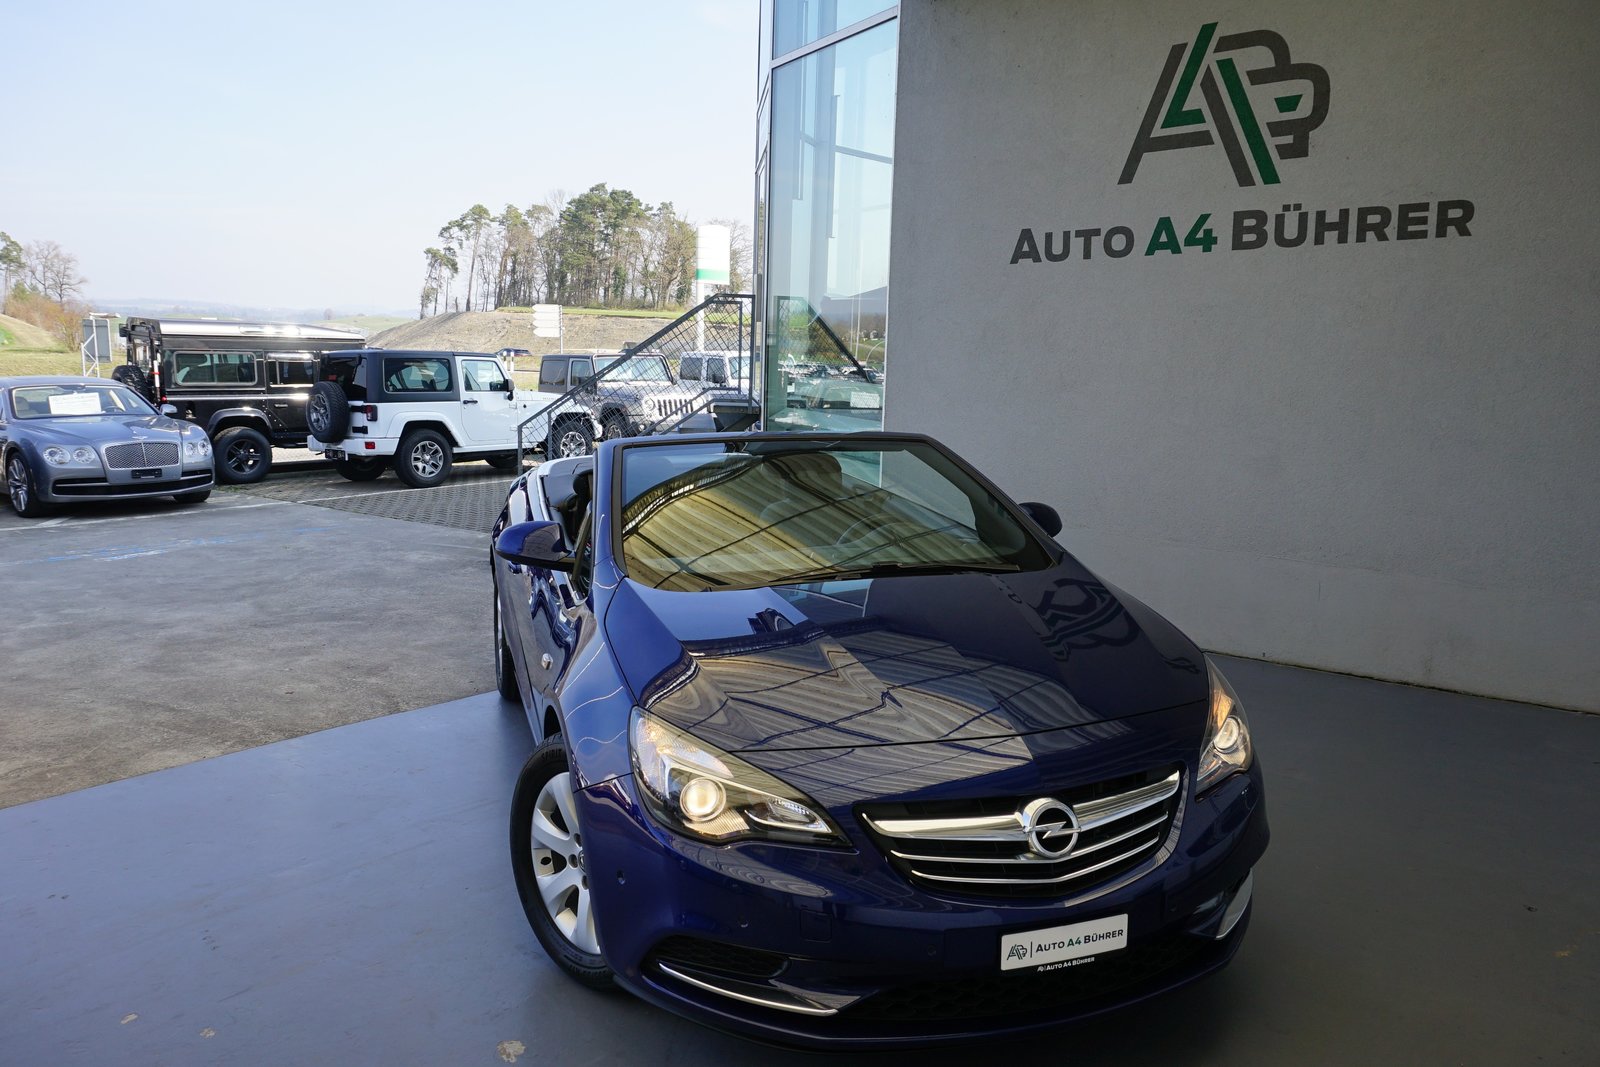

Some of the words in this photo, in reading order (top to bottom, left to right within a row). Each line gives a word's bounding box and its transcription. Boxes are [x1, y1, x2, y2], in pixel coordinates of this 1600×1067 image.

[1009, 226, 1134, 264] AUTO
[1145, 213, 1218, 256] A4
[1231, 200, 1475, 250] BÜHRER
[1036, 941, 1064, 952] AUTO
[1067, 937, 1082, 947] A4
[1084, 929, 1123, 944] BÜHRER
